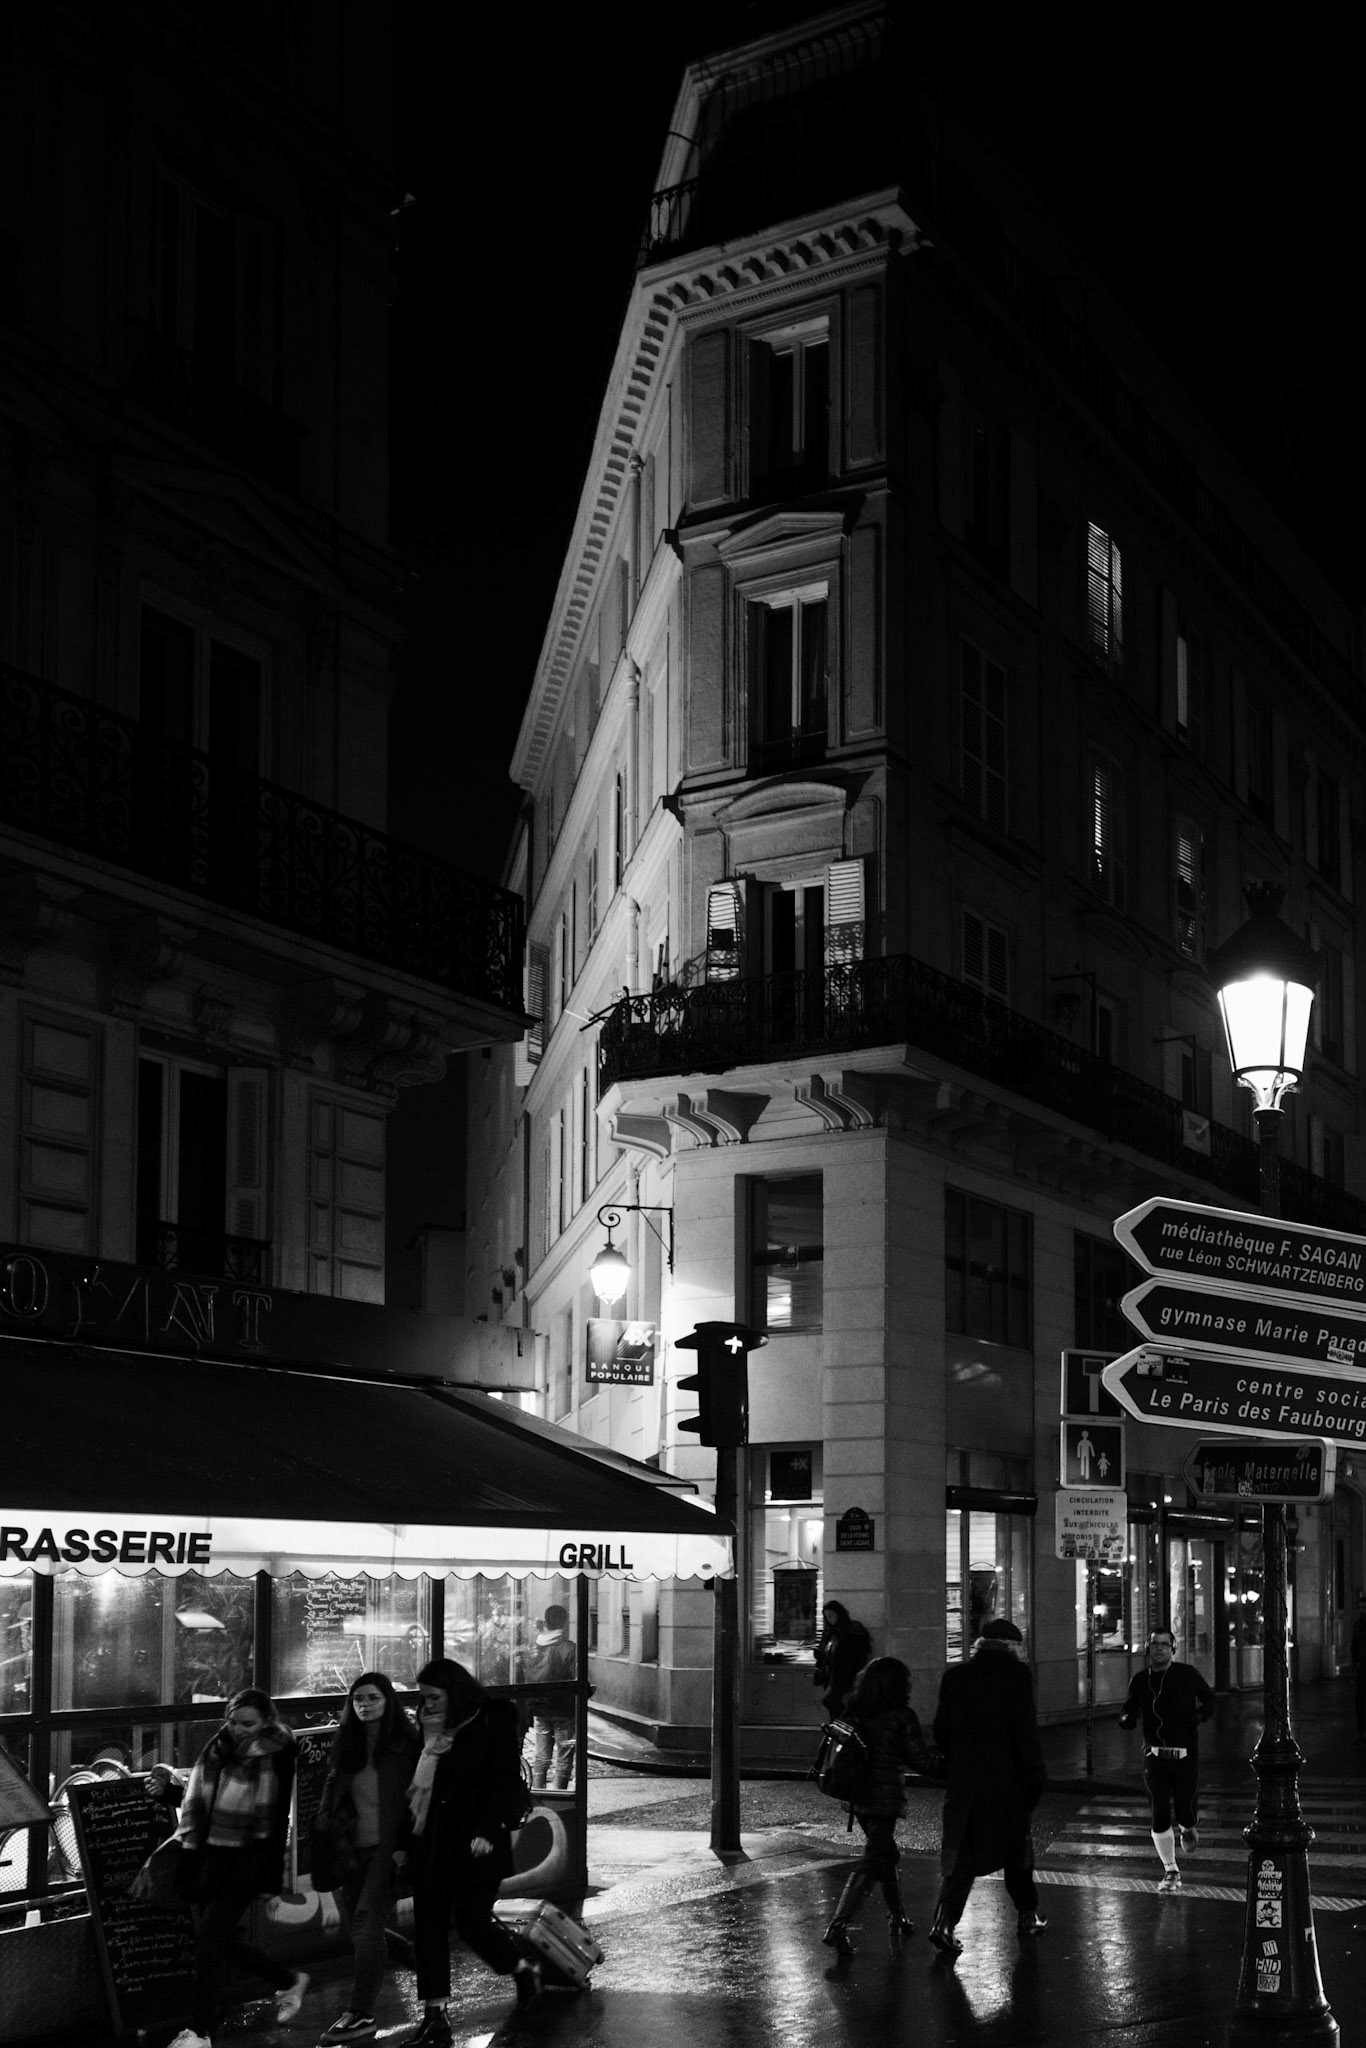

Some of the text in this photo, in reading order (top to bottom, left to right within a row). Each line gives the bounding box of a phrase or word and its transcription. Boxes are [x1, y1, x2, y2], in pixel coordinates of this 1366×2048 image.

[1161, 1222, 1362, 1271] médiathèque F. SAGAN
[1159, 1246, 1365, 1292] rue Léon SCHWARTZENBERG
[1160, 1307, 1247, 1333] gymnase
[1254, 1318, 1309, 1343] Marie
[590, 1362, 650, 1373] BANQUE
[590, 1371, 650, 1382] POPULAIRE
[1236, 1379, 1304, 1400] centre
[1149, 1388, 1172, 1408] Le
[1179, 1392, 1230, 1416] Paris
[1237, 1400, 1271, 1421] des
[1244, 1461, 1318, 1481] Maternelle
[0, 1526, 213, 1565] RASSERIE
[559, 1543, 634, 1571] GRILL
[1256, 1959, 1280, 1974] END
